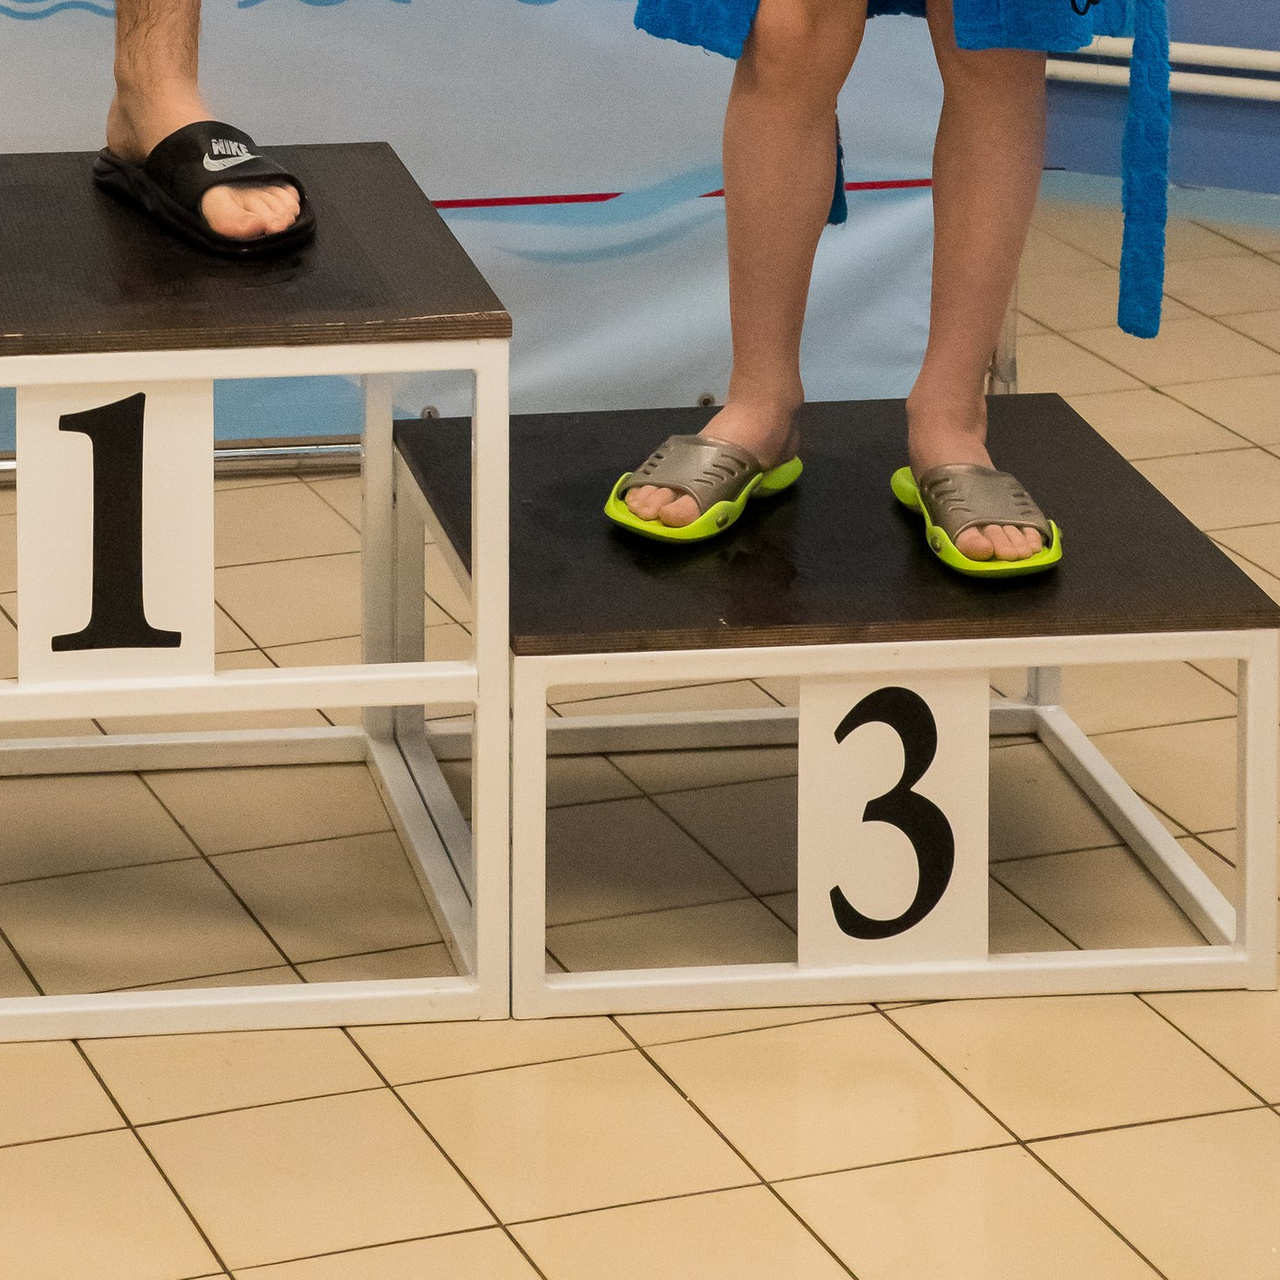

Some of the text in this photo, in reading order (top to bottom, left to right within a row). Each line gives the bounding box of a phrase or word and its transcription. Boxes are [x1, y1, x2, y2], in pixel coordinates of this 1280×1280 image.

[211, 139, 250, 157] NIKE
[51, 392, 182, 652] 1
[829, 686, 955, 940] 3
